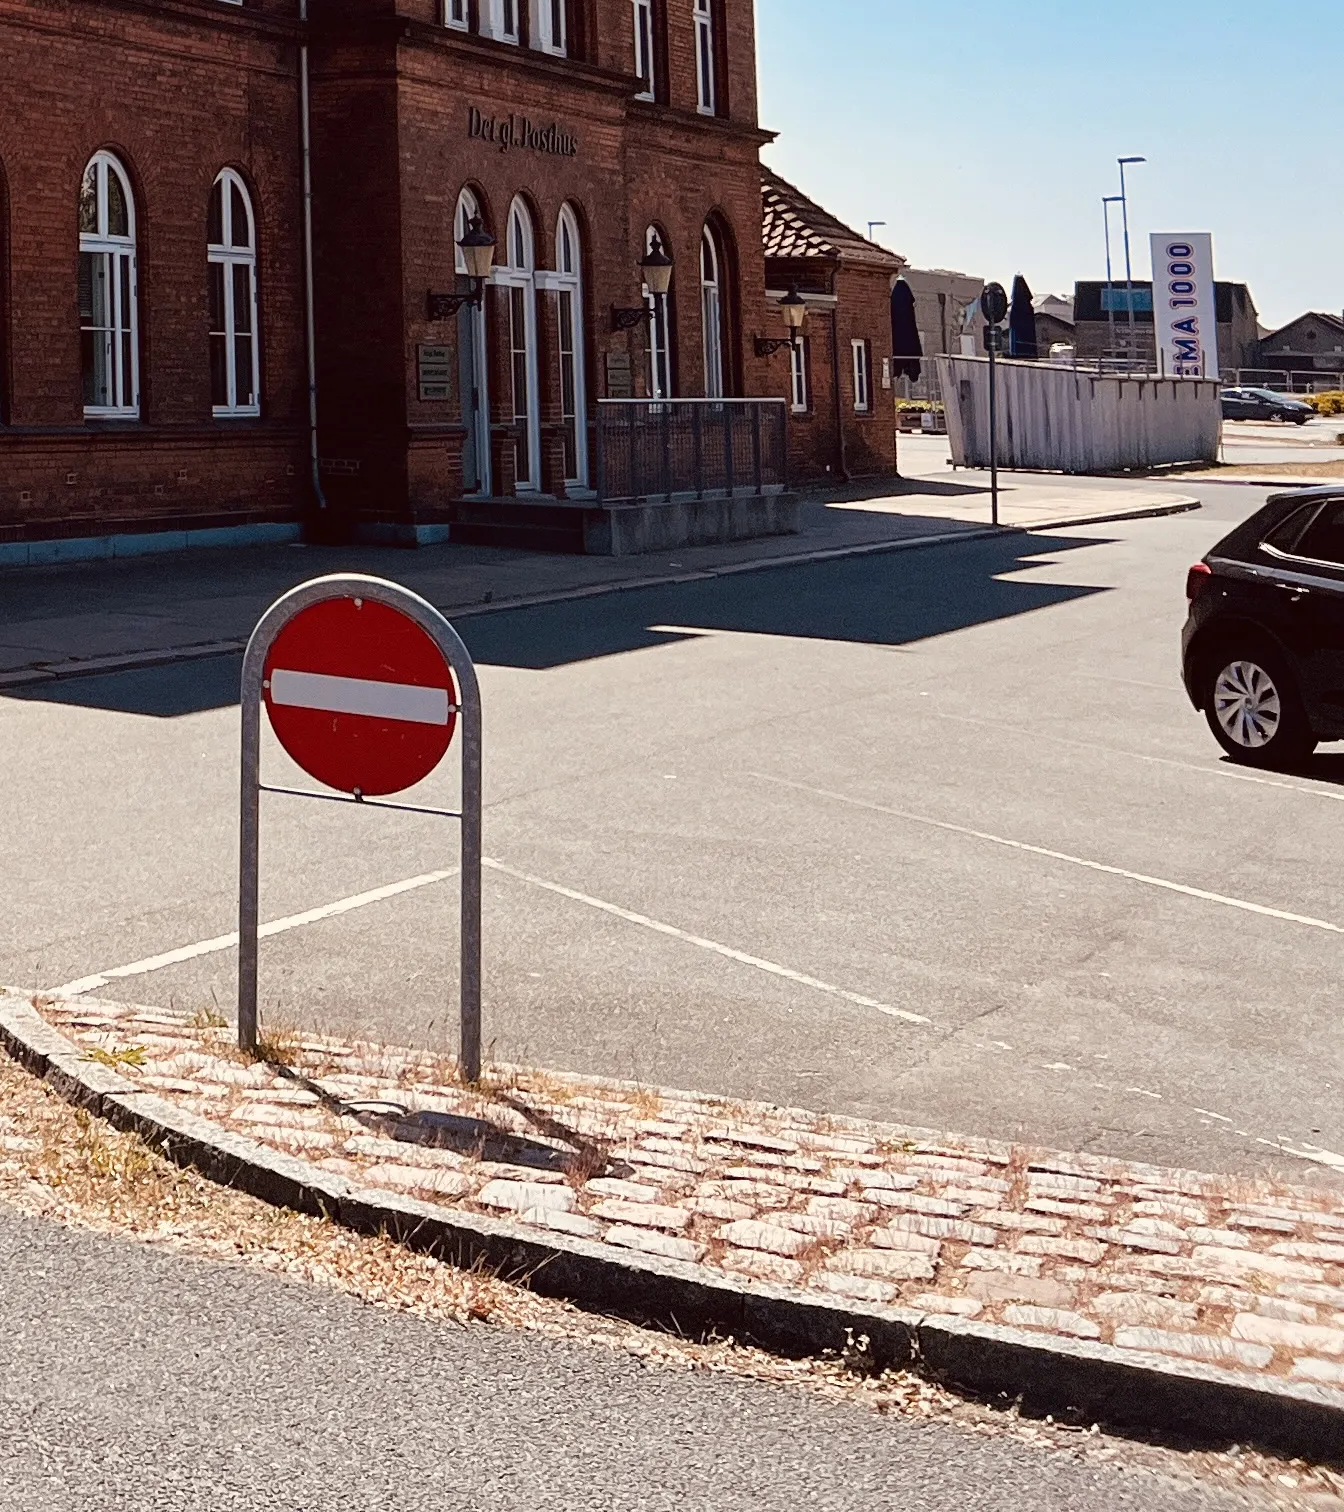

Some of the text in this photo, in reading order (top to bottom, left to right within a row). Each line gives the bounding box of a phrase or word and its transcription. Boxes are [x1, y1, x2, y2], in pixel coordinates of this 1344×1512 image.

[468, 107, 496, 141] Det
[521, 117, 578, 157] Posthus
[1166, 242, 1197, 310] 1000
